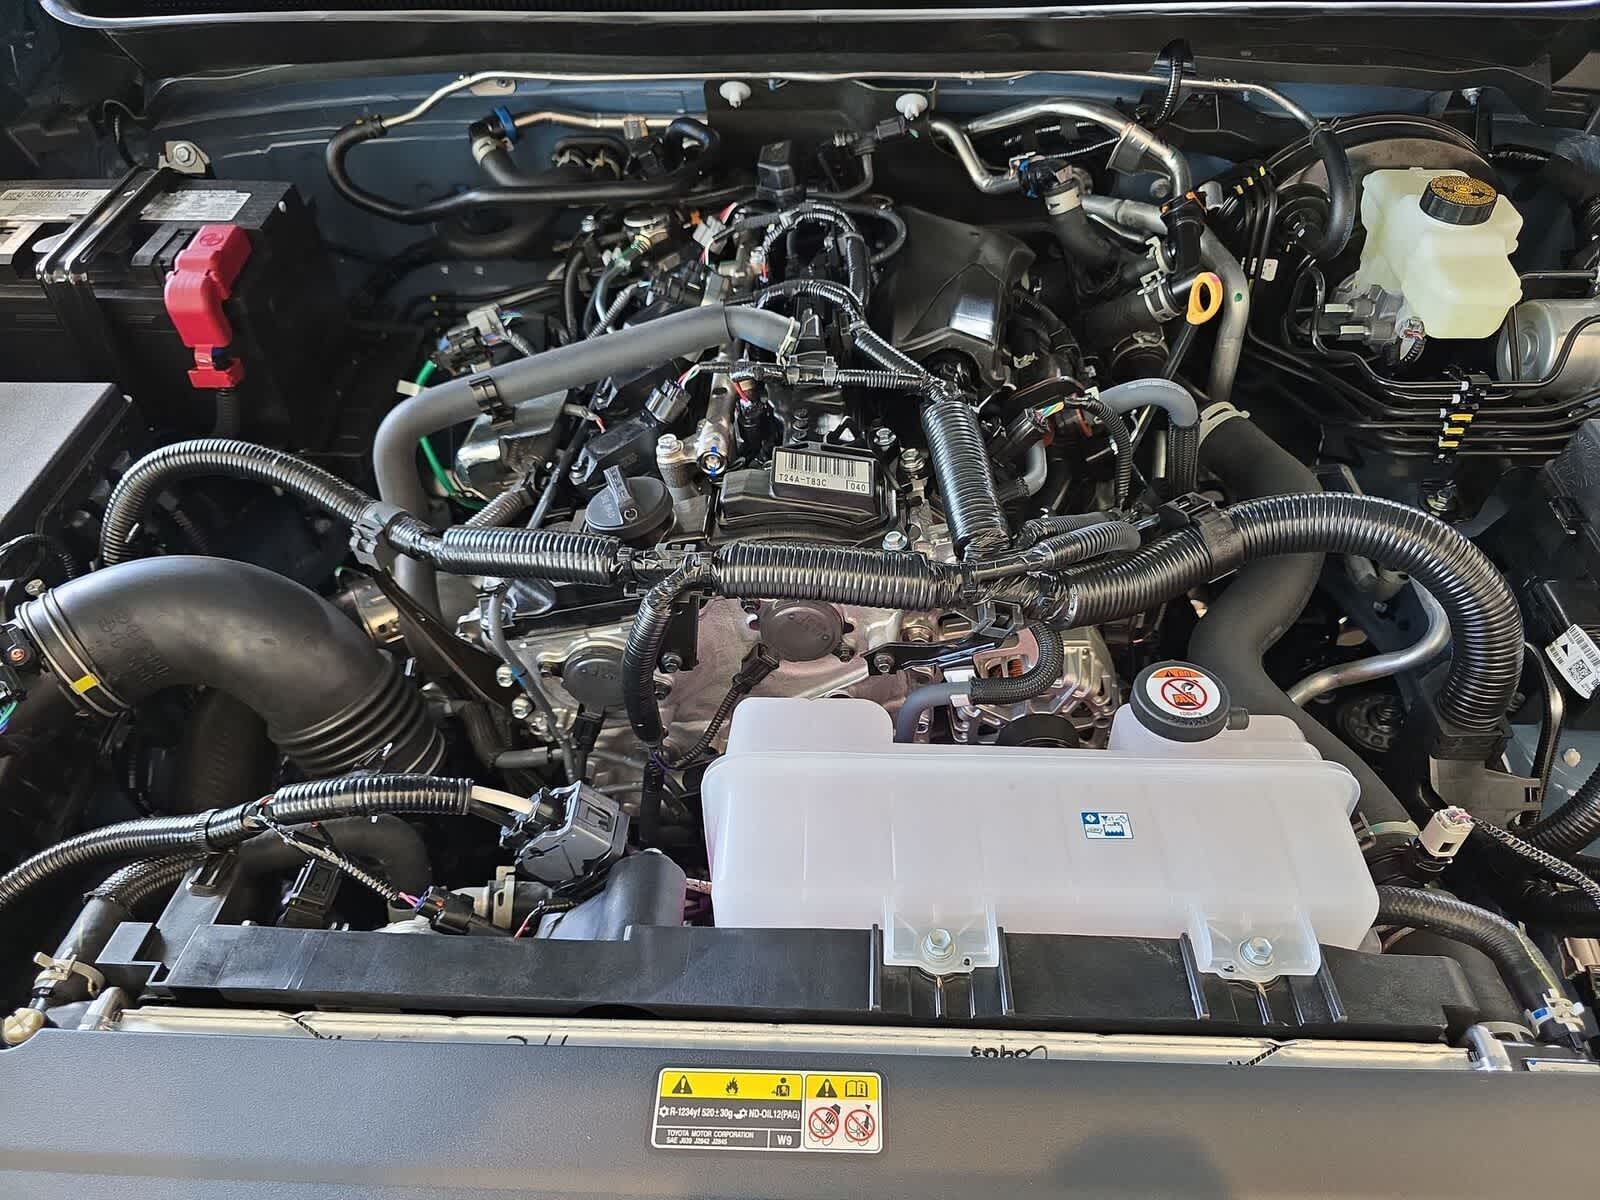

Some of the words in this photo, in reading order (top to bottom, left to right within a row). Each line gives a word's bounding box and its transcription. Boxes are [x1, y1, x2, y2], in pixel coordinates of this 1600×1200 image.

[778, 473, 827, 487] T24A-T83C
[850, 483, 866, 492] 040
[670, 1106, 701, 1118] R-1234yf
[702, 1108, 734, 1120] 520±30g
[749, 1108, 801, 1121] ND-OIL12(PAG)
[667, 1129, 690, 1137] TOYOTA
[691, 1130, 713, 1138] MOTOR
[713, 1130, 754, 1139] CORPORATION
[777, 1134, 793, 1146] W9
